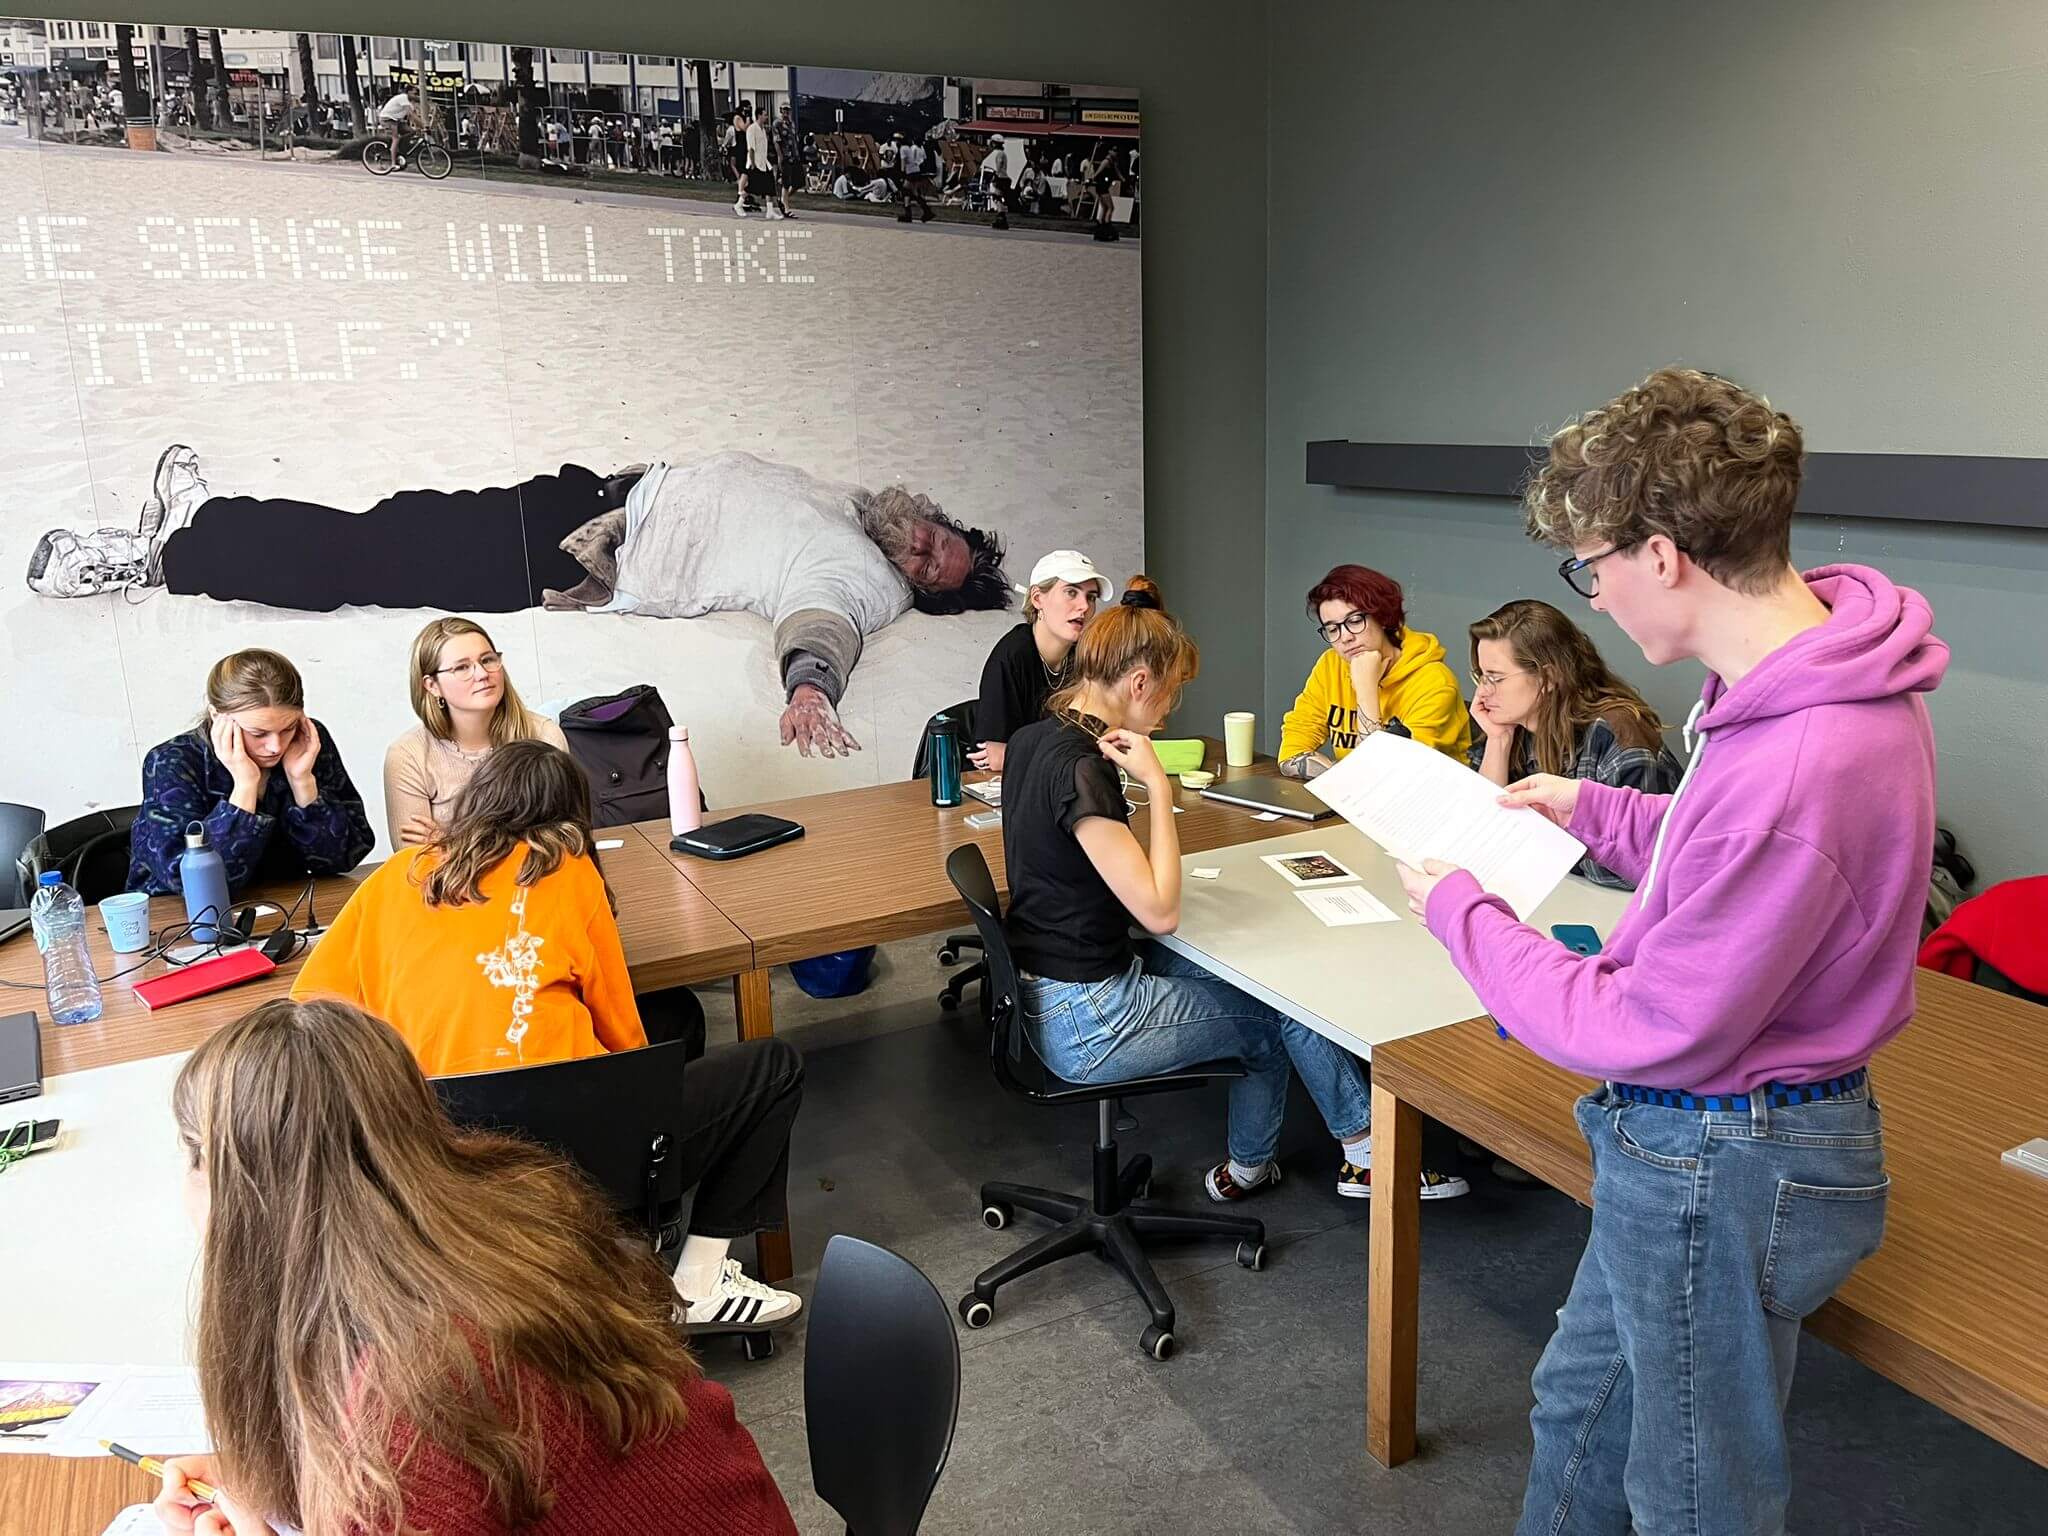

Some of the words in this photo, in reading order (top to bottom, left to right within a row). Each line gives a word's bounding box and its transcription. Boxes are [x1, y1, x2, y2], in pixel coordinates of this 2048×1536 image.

[390, 71, 464, 88] TATOOS
[137, 217, 409, 280] SENSE
[446, 221, 628, 282] WILL
[648, 228, 816, 283] TAKE
